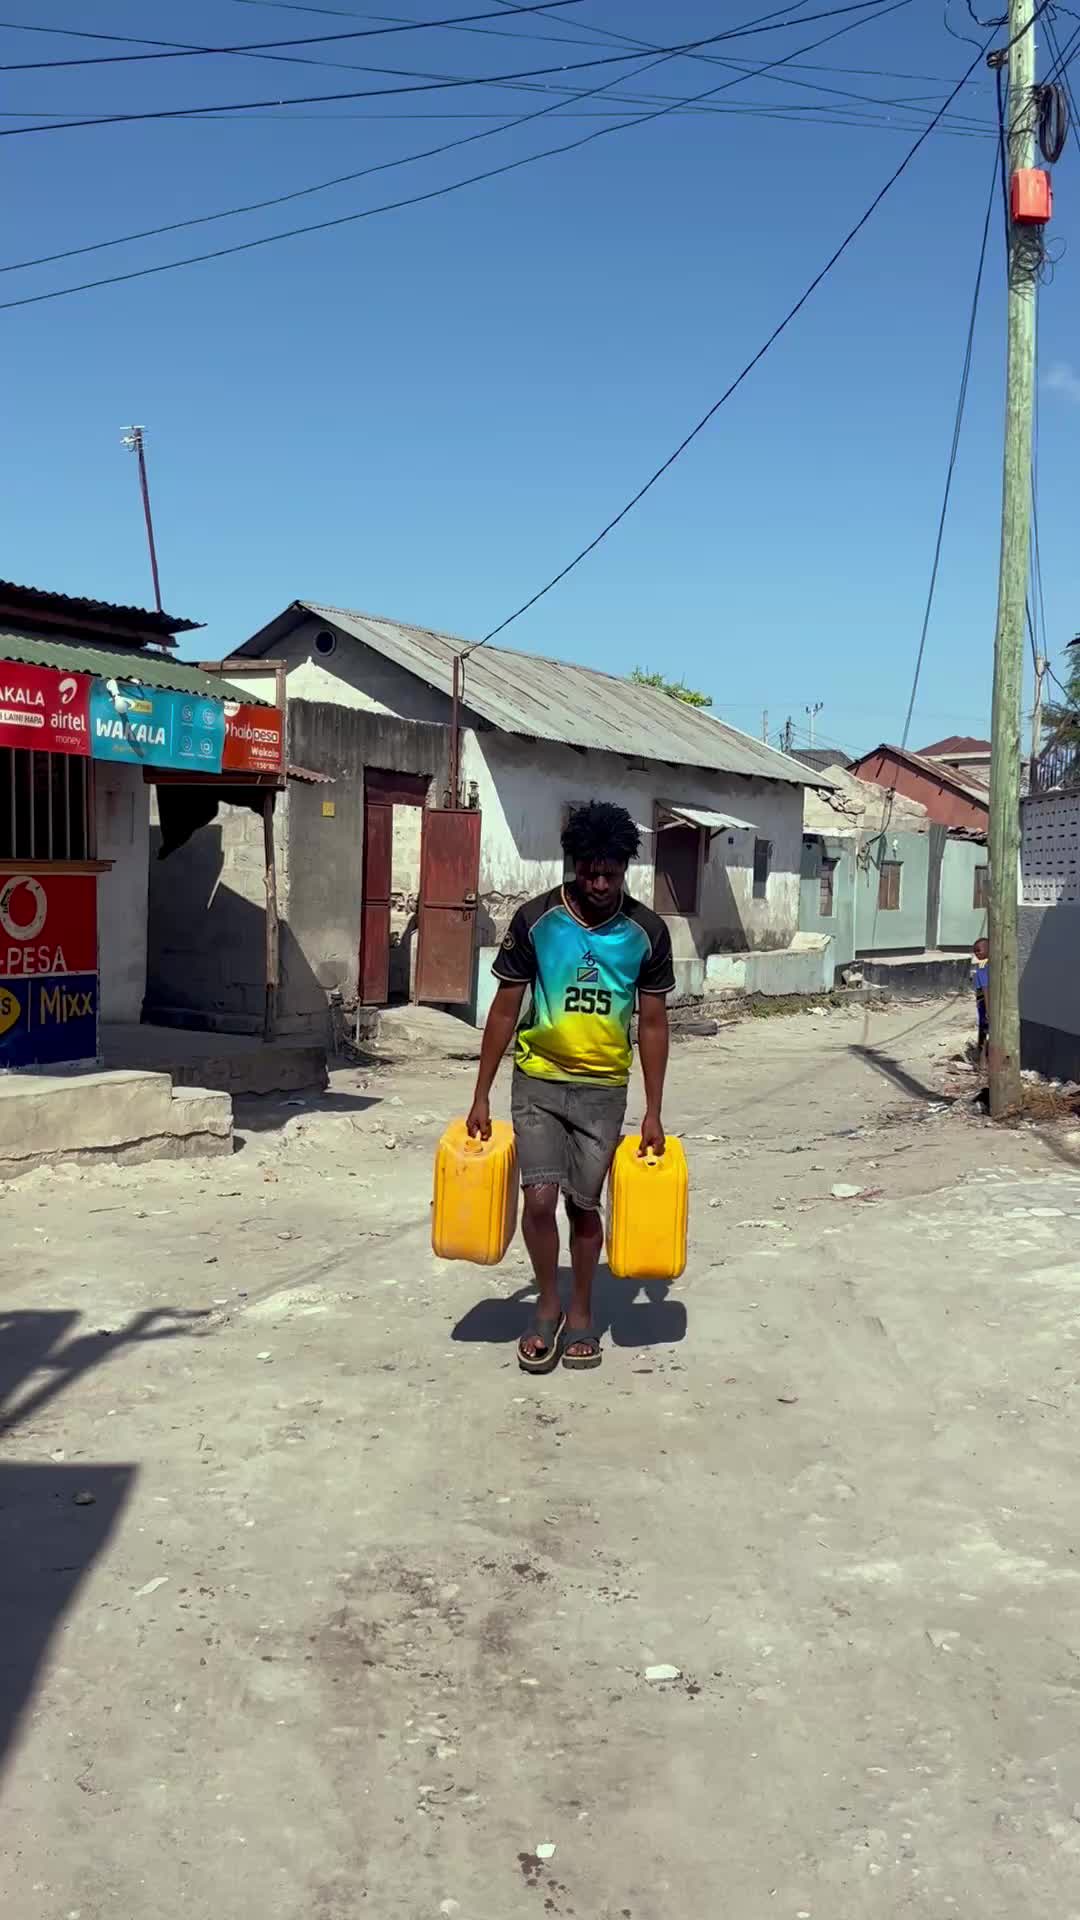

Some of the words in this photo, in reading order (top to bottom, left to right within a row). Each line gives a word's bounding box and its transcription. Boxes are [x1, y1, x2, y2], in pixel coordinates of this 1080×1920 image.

[51, 710, 86, 731] airtel
[96, 718, 166, 745] WAKALA
[56, 735, 81, 747] money
[40, 985, 94, 1024] Mixx
[564, 986, 612, 1015] 255
